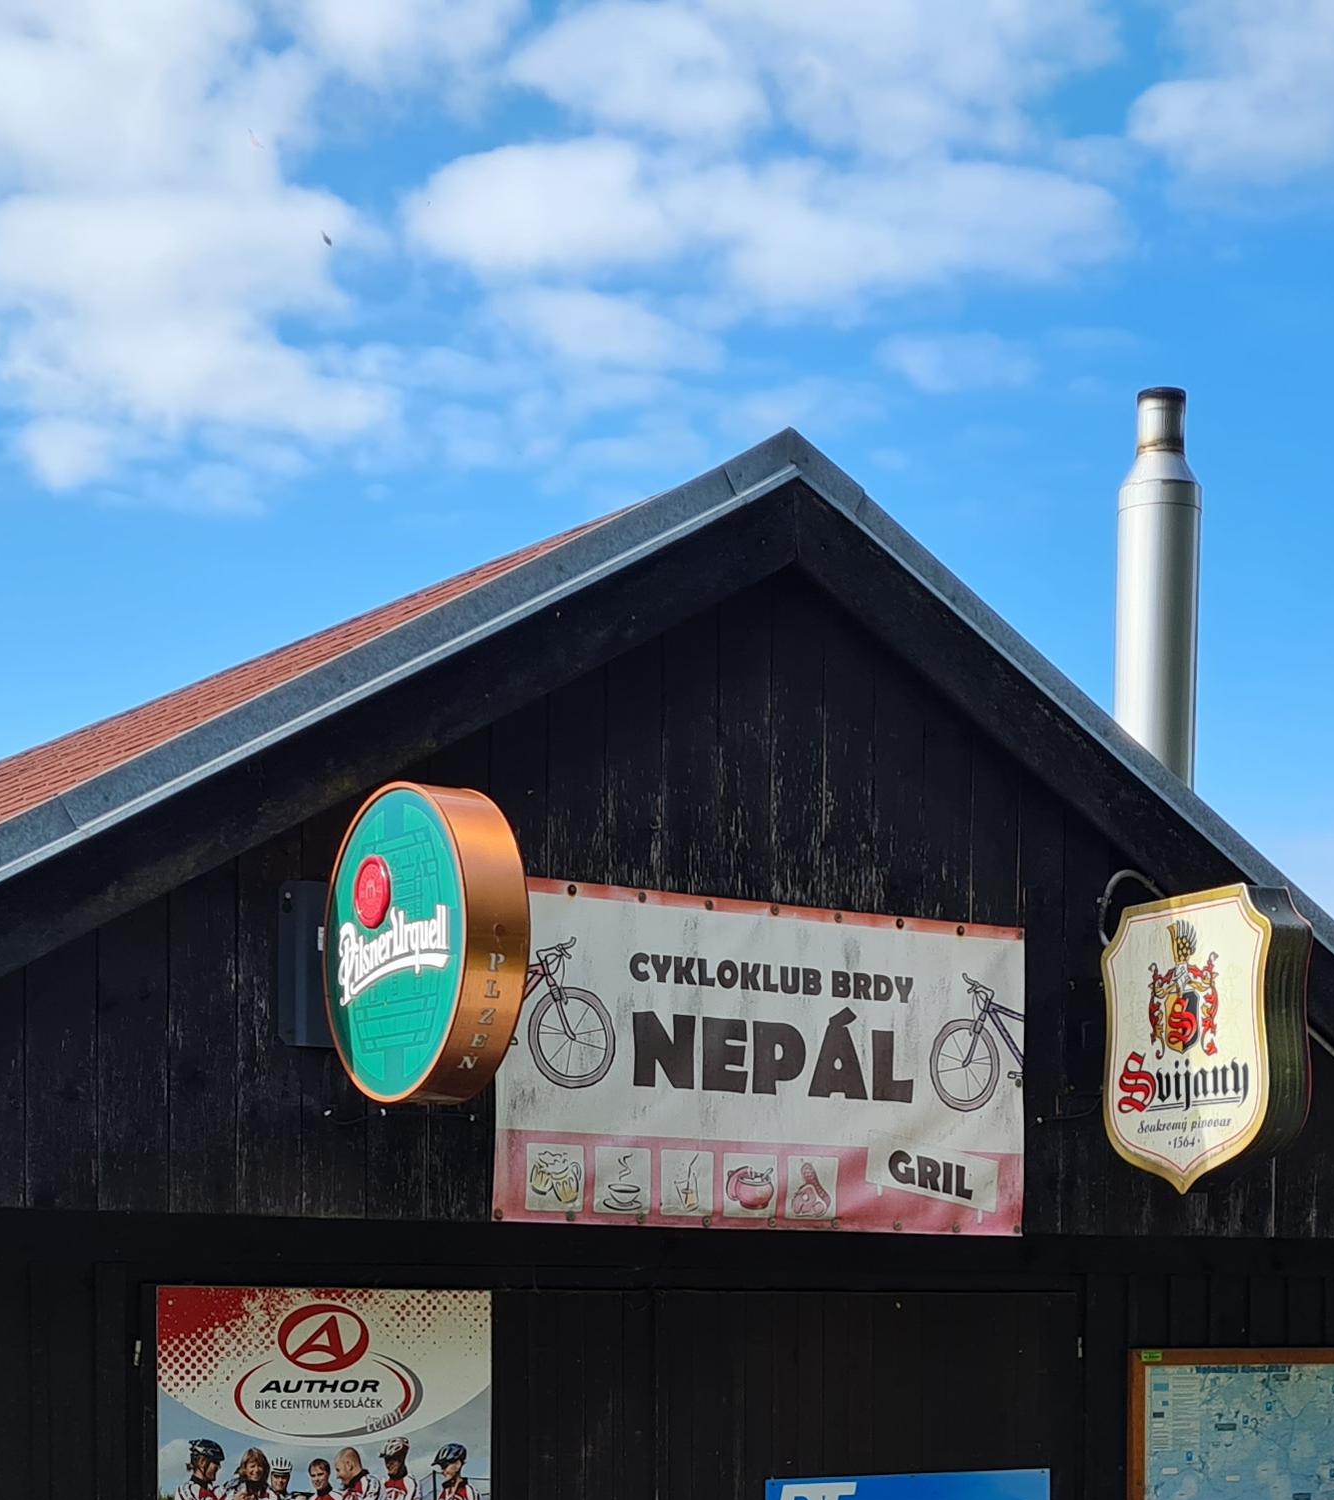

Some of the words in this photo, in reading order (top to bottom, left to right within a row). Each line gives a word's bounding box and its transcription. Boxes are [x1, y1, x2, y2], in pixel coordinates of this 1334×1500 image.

[338, 922, 392, 1007] Pilsner
[391, 905, 450, 975] Urquell
[629, 952, 823, 996] CYKLOKLUB
[831, 972, 914, 1004] BRDY
[631, 1006, 914, 1104] NEPÁL
[1117, 1051, 1250, 1114] Svijany
[1190, 1117, 1232, 1132] pivovar
[888, 1150, 973, 1200] GRIL
[254, 1399, 278, 1410] BIKE
[280, 1398, 330, 1409] CENTRUM
[332, 1396, 384, 1409] SEDLÁČEK
[259, 1379, 380, 1394] AUTHOR
